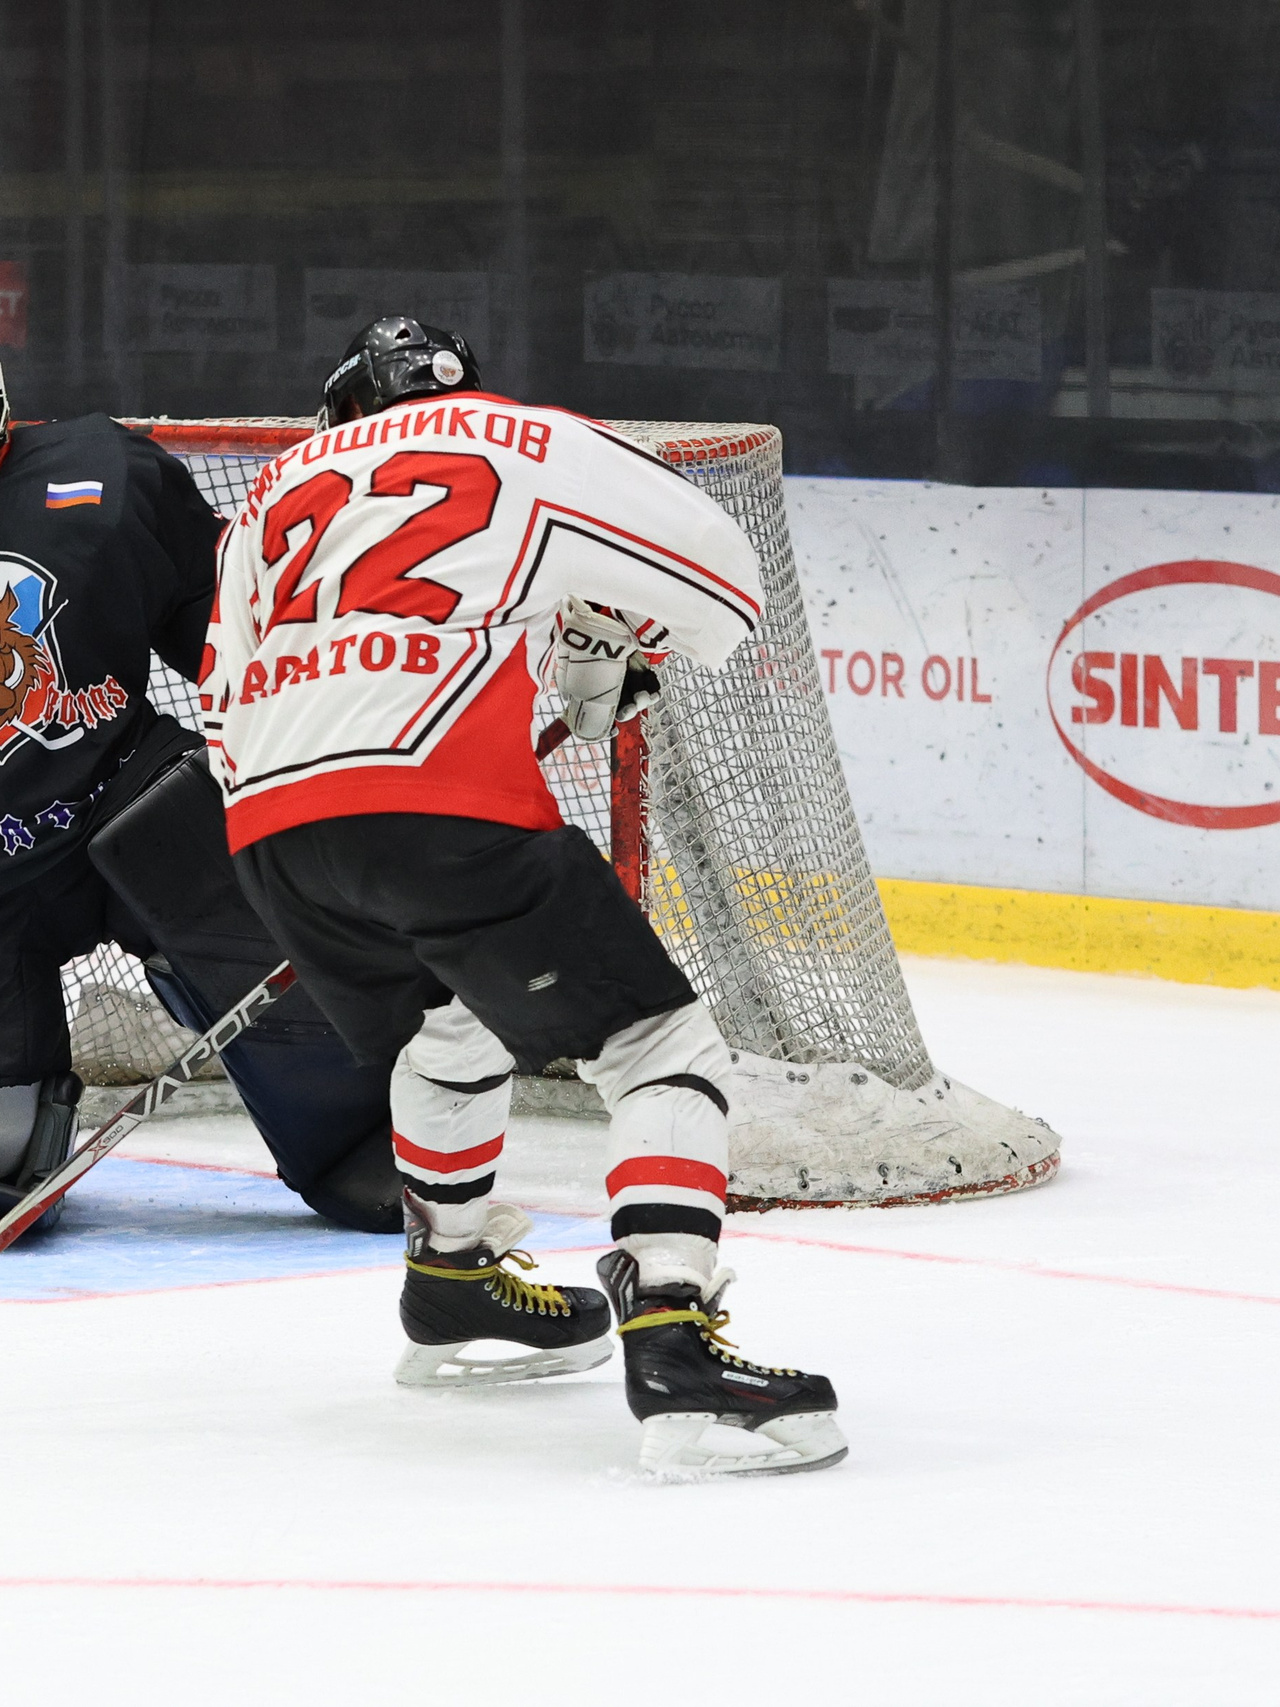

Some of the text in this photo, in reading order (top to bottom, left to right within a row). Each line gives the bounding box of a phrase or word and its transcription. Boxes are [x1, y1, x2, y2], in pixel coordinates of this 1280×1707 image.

[261, 449, 503, 625] 22
[239, 630, 441, 706] АРАТОВ
[920, 656, 992, 703] OIL
[1071, 650, 1280, 735] SINTE
[121, 981, 277, 1121] VAPOR
[87, 1123, 125, 1164] X900
